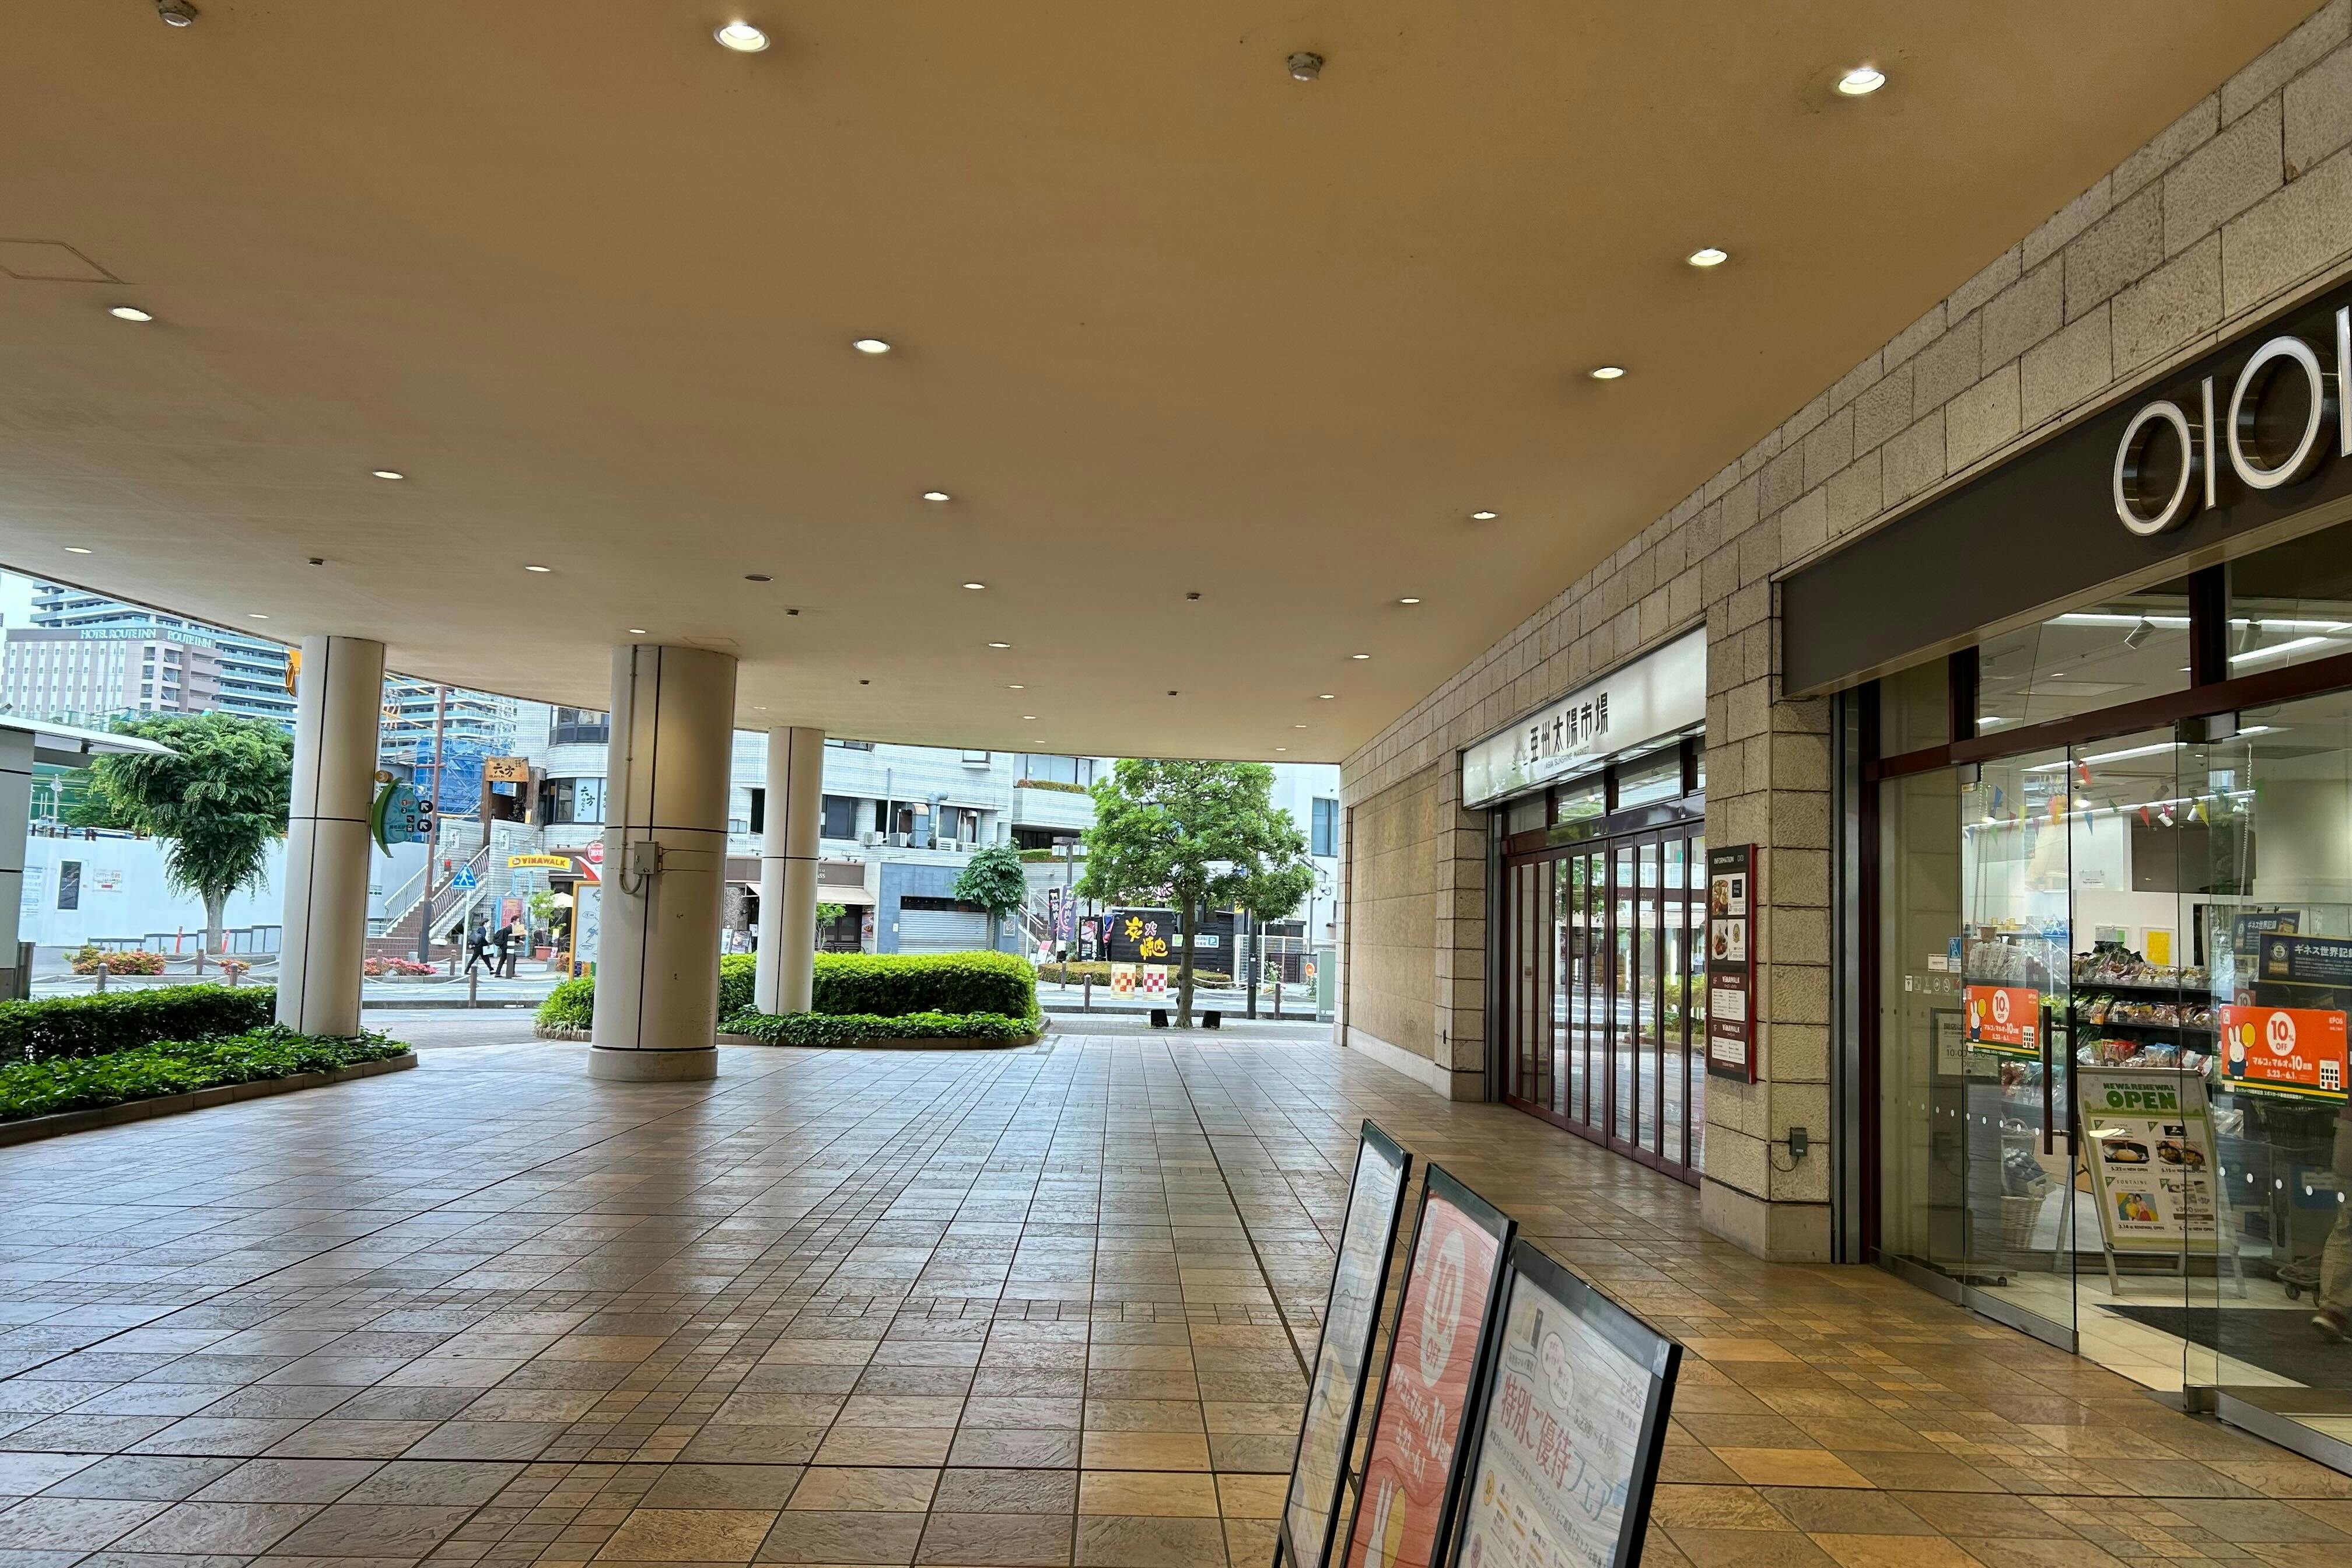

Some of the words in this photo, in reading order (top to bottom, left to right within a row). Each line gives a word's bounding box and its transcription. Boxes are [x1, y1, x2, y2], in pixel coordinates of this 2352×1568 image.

[80, 629, 108, 639] HOTEL
[109, 629, 138, 639] ROUTE
[138, 628, 156, 639] INN
[167, 630, 195, 645] ROUTE
[195, 637, 212, 648] INN
[1714, 856, 1734, 864] INFORMATION
[2276, 1042, 2287, 1051] OFF
[2106, 1090, 2178, 1110] OPEN
[1426, 1336, 1441, 1368] OFF
[1500, 1373, 1614, 1521] 特別ご優待フェア
